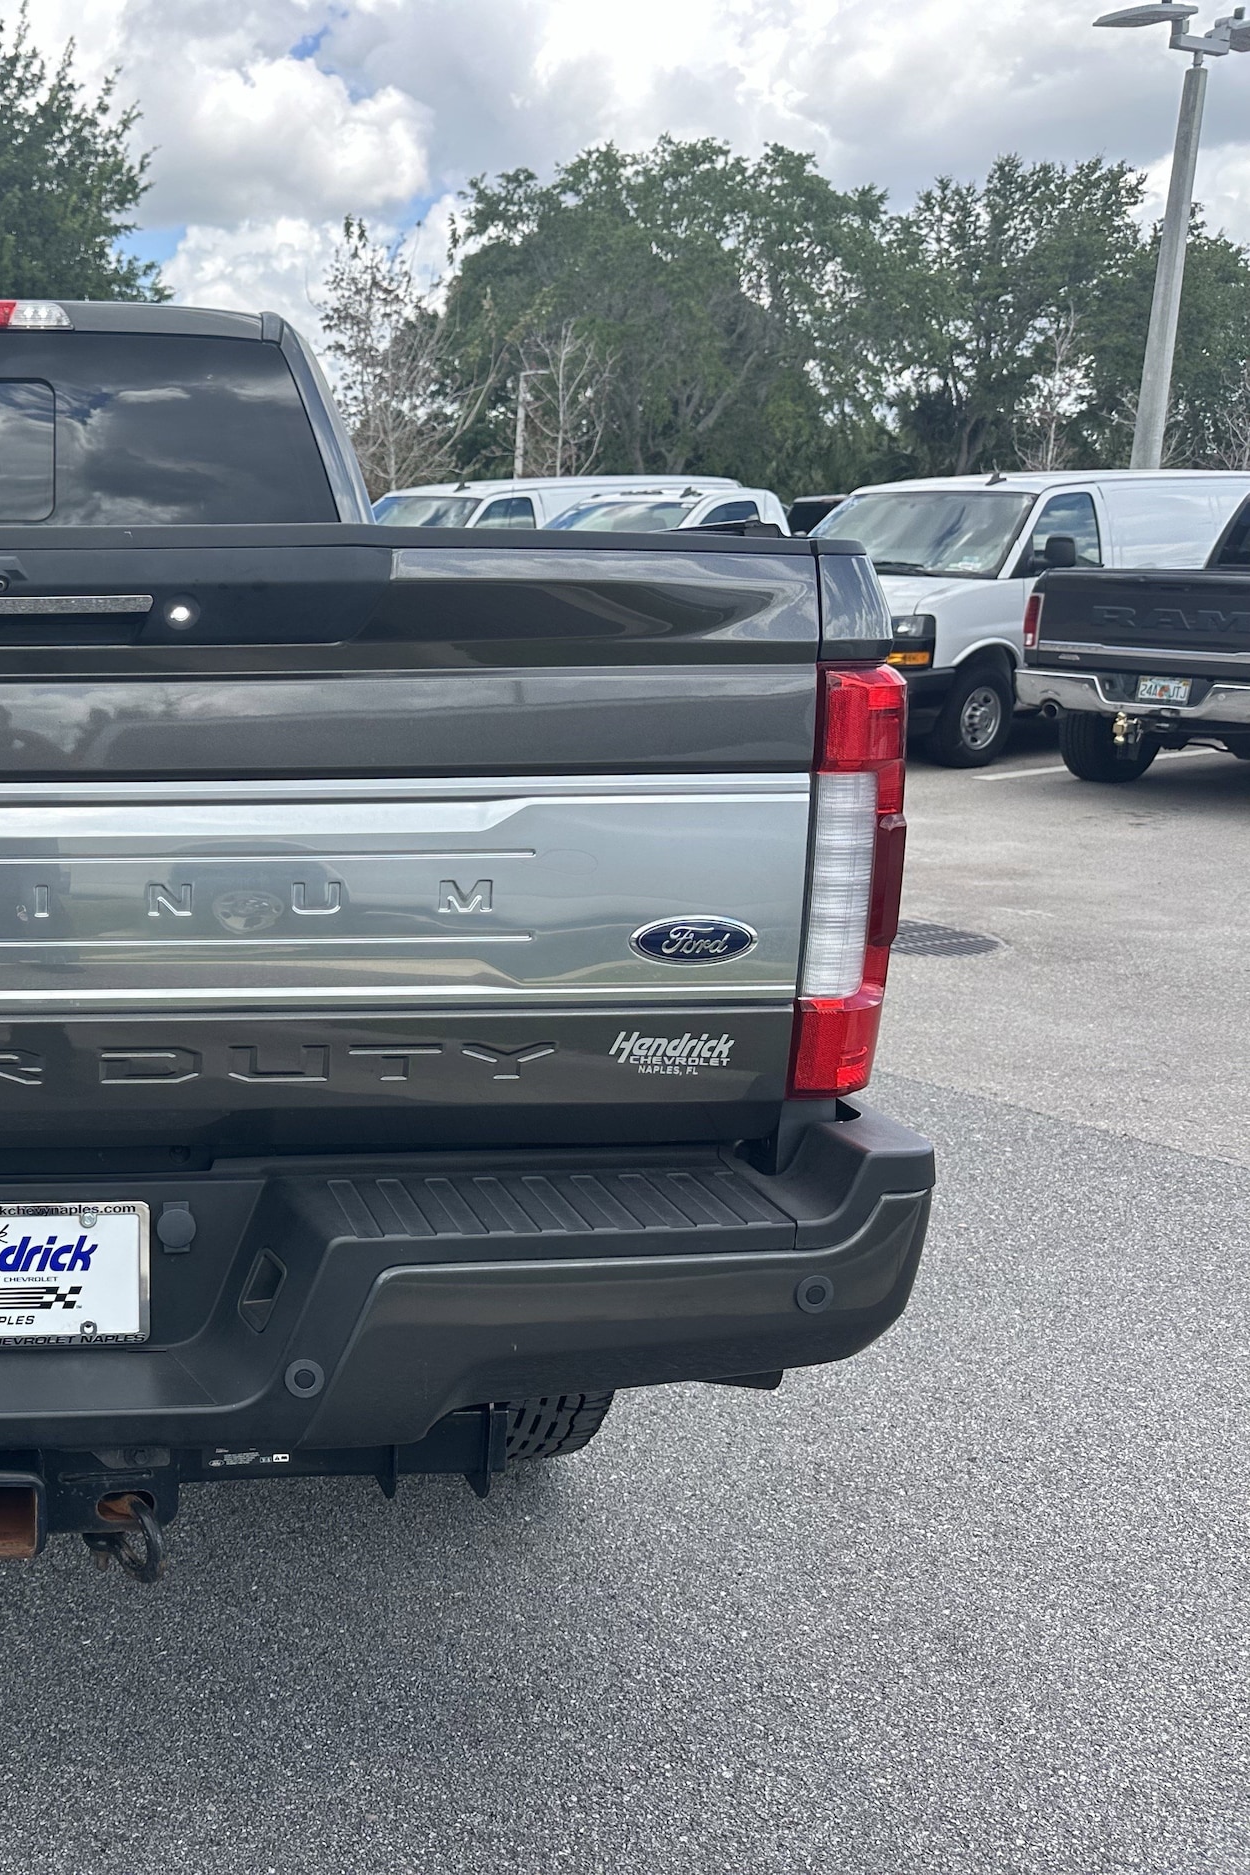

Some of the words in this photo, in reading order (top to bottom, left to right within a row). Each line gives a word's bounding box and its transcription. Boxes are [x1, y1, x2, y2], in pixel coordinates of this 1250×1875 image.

[1092, 605, 1250, 633] RAM
[662, 926, 731, 954] Ford
[608, 1031, 736, 1064] Hendrick
[629, 1056, 731, 1067] CHEVROLET
[99, 1041, 557, 1085] DUTY
[637, 1065, 683, 1076] NAPLES,
[685, 1066, 699, 1075] FL
[80, 1333, 146, 1344] NAPLES
